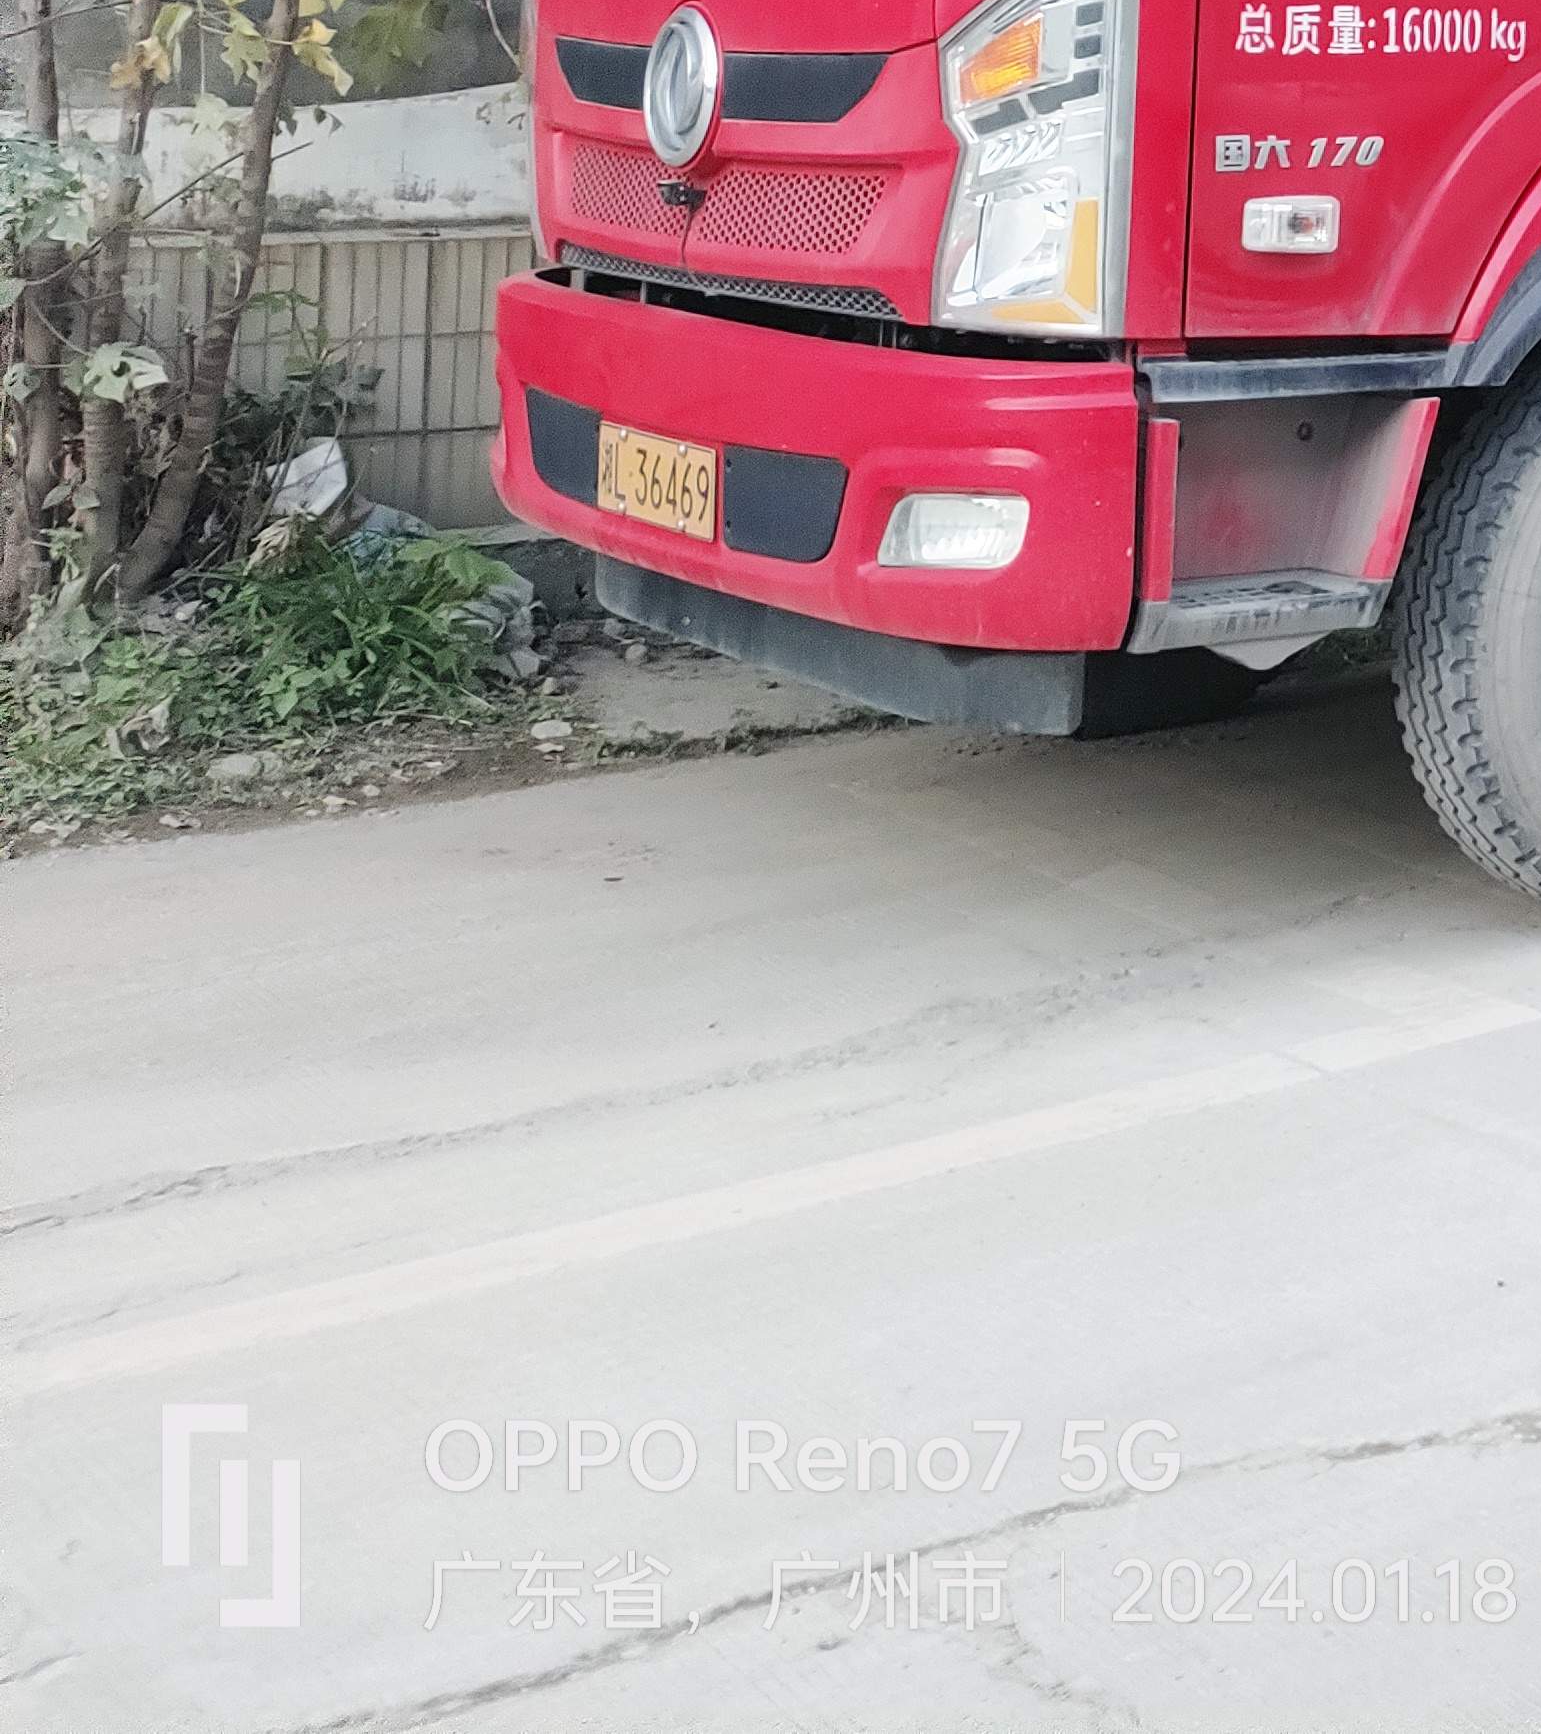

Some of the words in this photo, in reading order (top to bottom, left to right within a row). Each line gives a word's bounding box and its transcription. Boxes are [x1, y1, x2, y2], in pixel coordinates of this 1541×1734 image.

[1490, 8, 1527, 62] kg
[1215, 134, 1291, 172] 国六
[1307, 135, 1384, 168] 170
